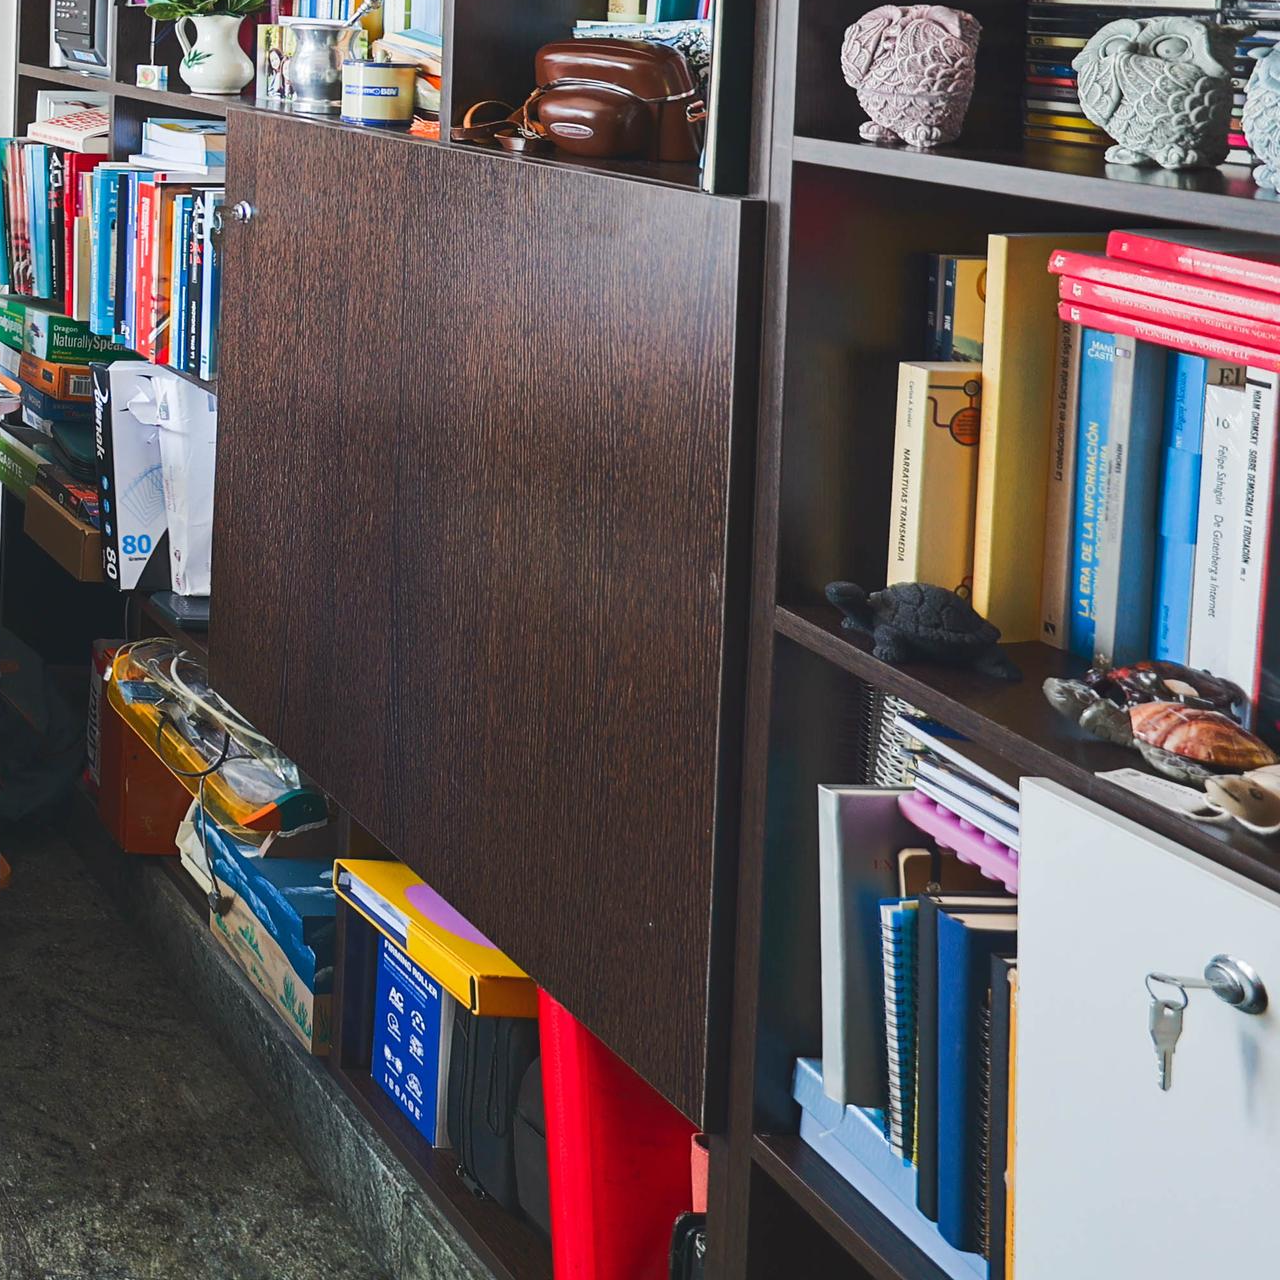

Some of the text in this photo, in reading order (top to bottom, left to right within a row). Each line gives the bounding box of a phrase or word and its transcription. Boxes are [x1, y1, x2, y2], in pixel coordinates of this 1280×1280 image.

[52, 334, 123, 353] NaturallySpea
[53, 324, 78, 333] Dragon
[1058, 370, 1069, 400] Escuela
[1249, 411, 1261, 446] CHOMSKY
[1216, 444, 1229, 470] Felipe
[1247, 449, 1258, 472] SOBRE
[897, 447, 911, 563] NARRATIVAS TRANSMEDIA
[1244, 473, 1257, 517] DEMOCRACIA
[1078, 421, 1100, 618] LA ERA DE LA INFORMACIÓN
[1214, 514, 1224, 527] De
[122, 534, 153, 556] 80
[1208, 529, 1224, 576] Gutenberg
[1241, 525, 1253, 565] EDUCACIÓN
[106, 545, 119, 581] 80
[1208, 582, 1219, 618] Internet
[384, 939, 412, 974] FIRMING
[412, 959, 438, 1000] ROLLER
